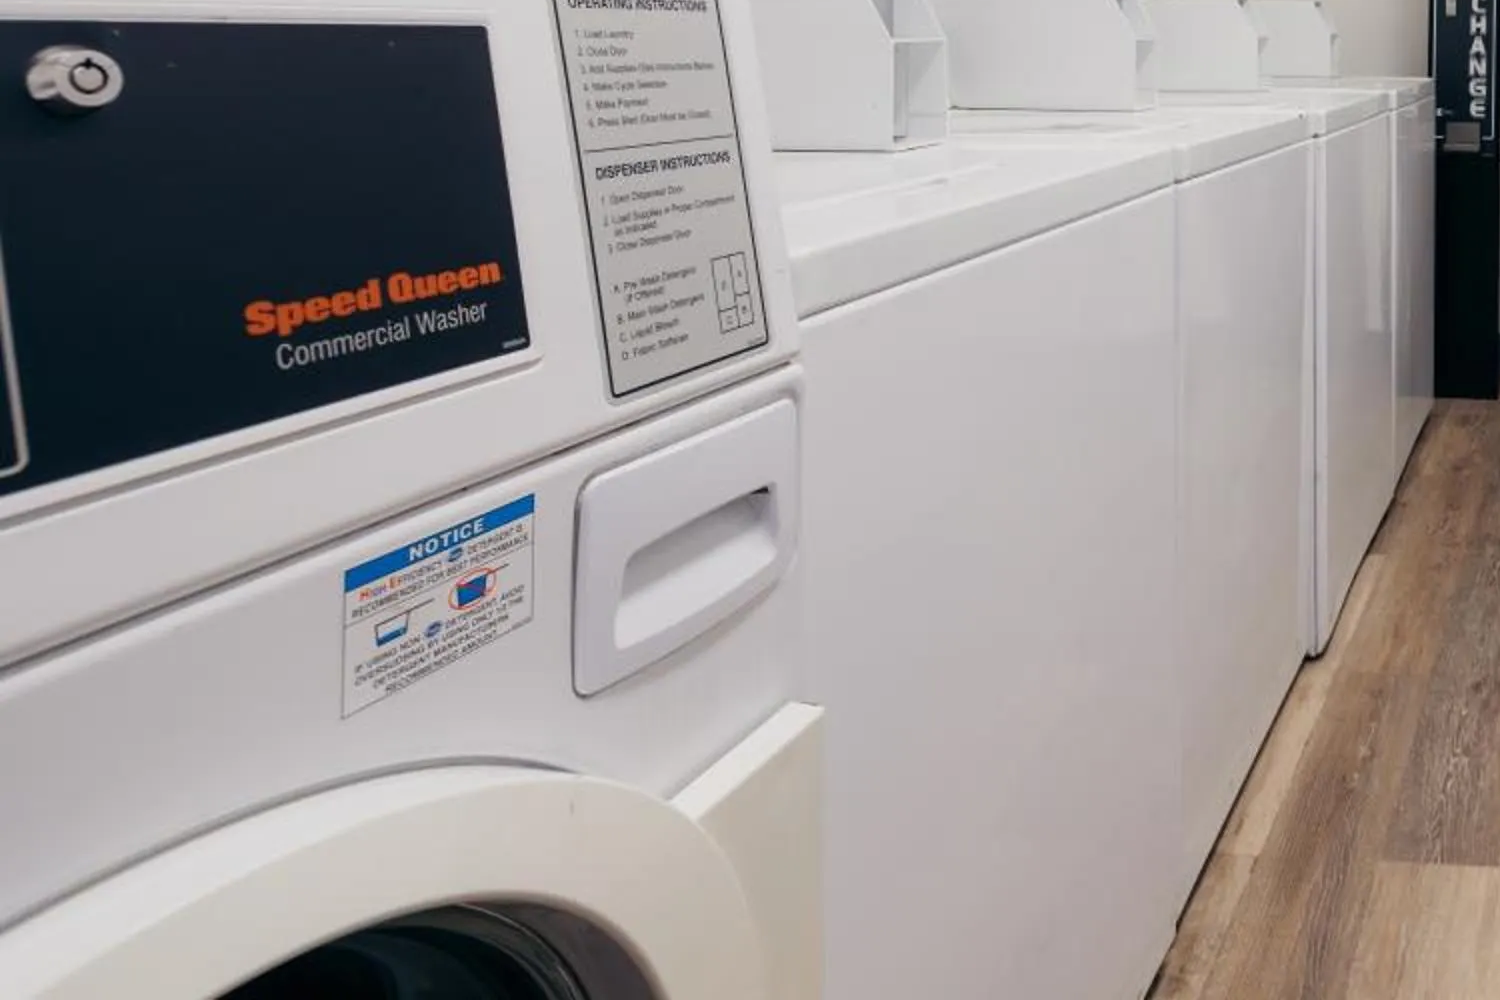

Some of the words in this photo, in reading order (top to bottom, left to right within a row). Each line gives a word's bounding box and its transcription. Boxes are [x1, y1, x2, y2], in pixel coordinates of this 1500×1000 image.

[595, 159, 659, 181] DISPENSER
[659, 150, 731, 171] INSTRUCTIONS
[244, 277, 383, 336] Speed
[387, 261, 504, 304] Queen
[275, 318, 411, 370] Commercial
[414, 301, 488, 337] Washer
[409, 517, 485, 561] NOTICE
